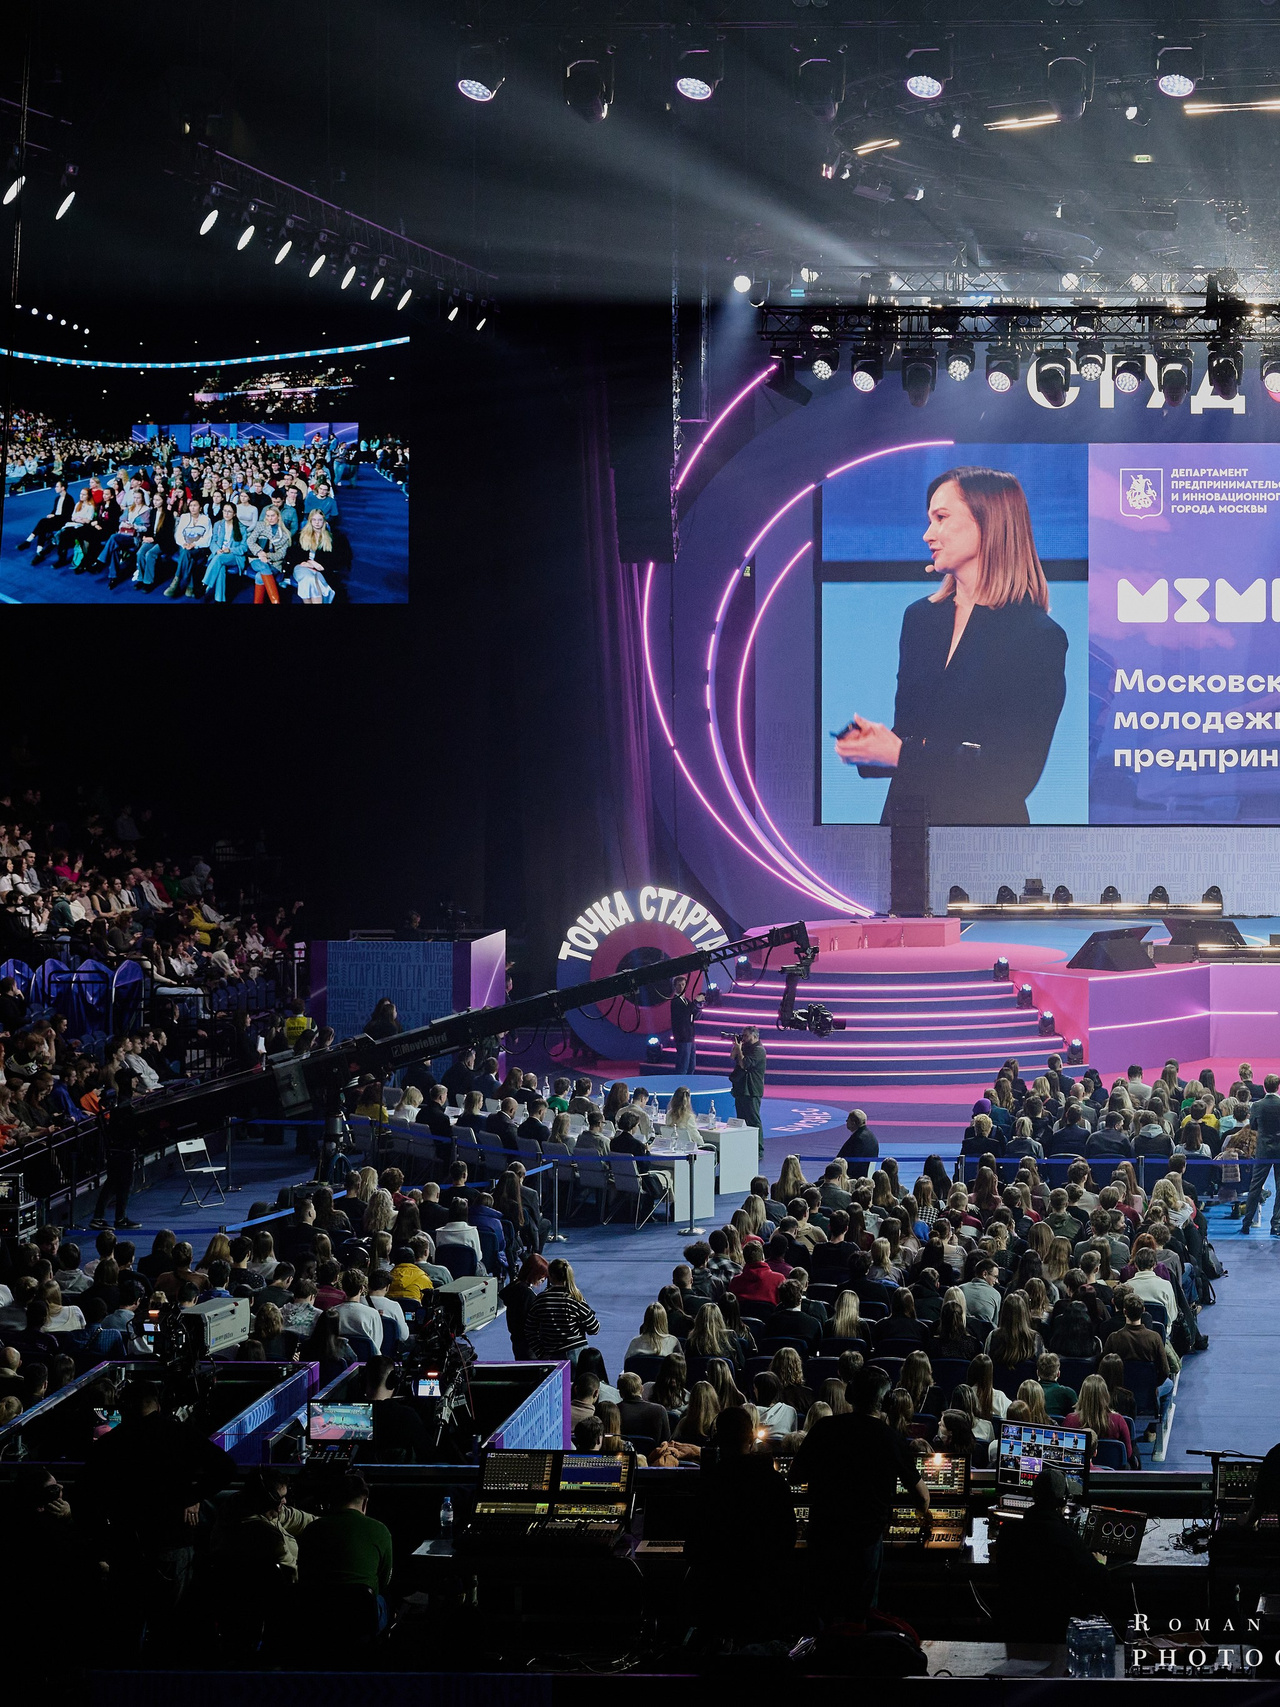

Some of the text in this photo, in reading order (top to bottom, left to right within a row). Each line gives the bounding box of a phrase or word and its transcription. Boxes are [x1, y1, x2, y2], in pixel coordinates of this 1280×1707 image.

[1171, 468, 1249, 478] ДЕПАРТАМЕНТ
[1171, 492, 1179, 501] И
[1171, 504, 1267, 515] ГОРОДА МОСКВЫ
[558, 886, 729, 962] ТОЧКА СТАРТА
[401, 1033, 448, 1054] MovieBird
